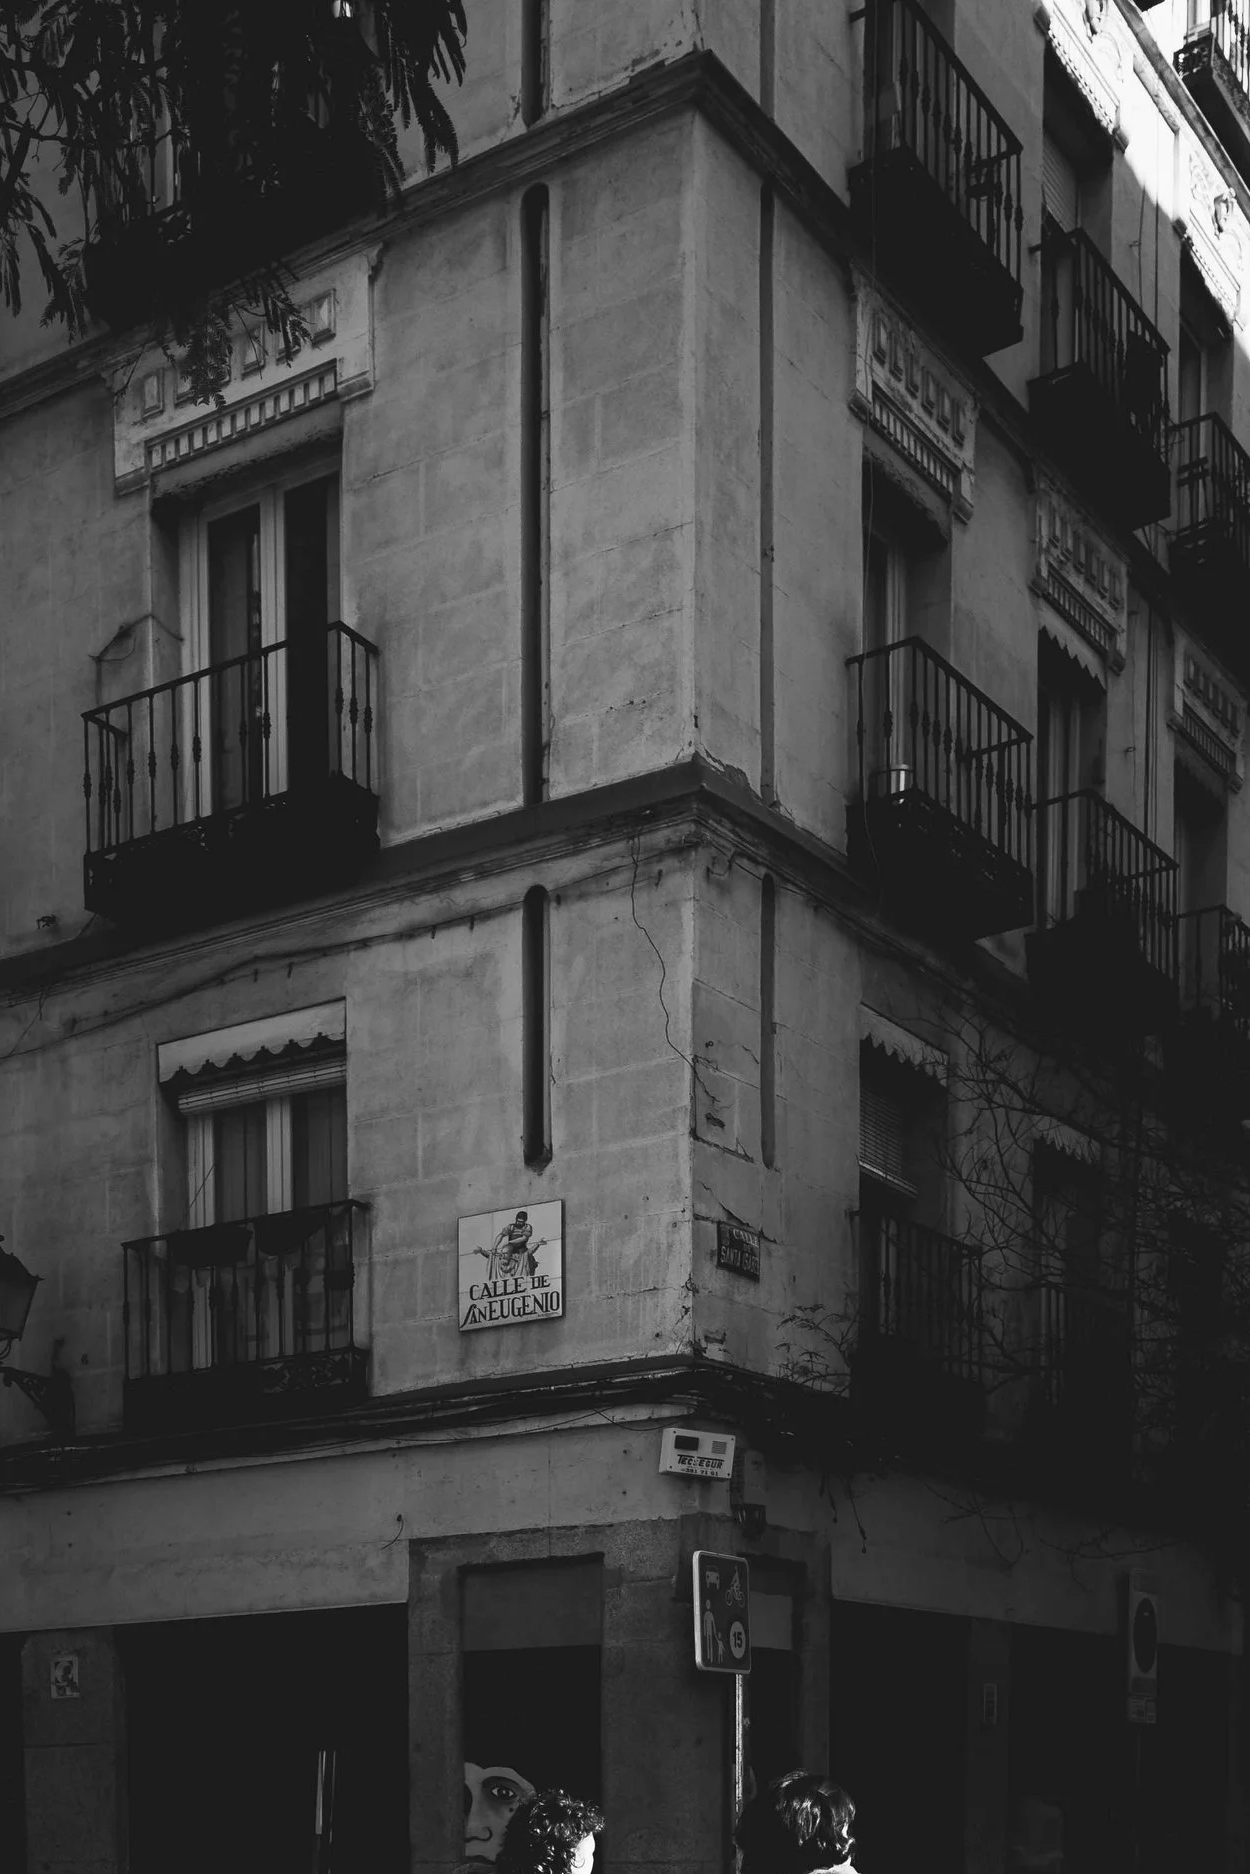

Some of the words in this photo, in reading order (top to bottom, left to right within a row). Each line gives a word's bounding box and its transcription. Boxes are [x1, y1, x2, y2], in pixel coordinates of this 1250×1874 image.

[469, 1276, 527, 1301] CALLE
[530, 1274, 551, 1290] DE
[733, 1631, 743, 1648] 15
